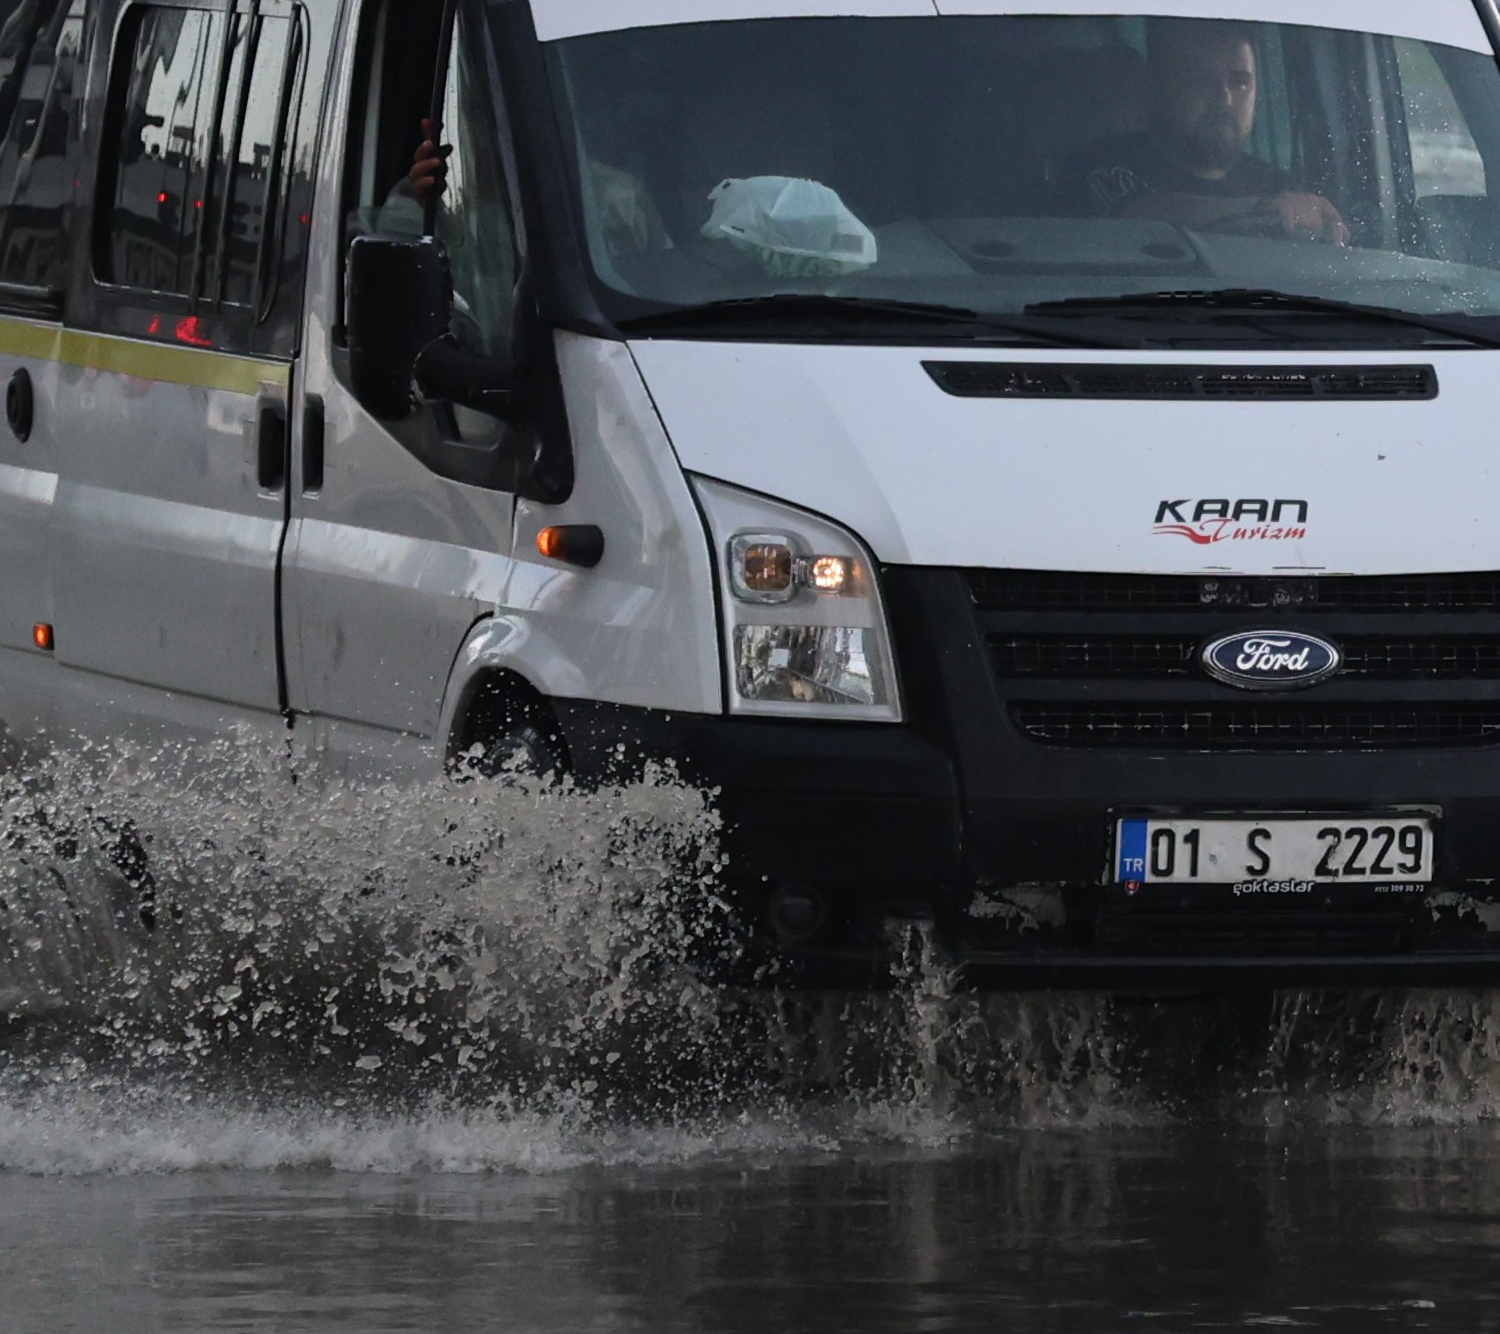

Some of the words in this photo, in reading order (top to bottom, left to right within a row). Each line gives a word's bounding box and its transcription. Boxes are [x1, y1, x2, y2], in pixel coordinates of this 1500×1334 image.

[1154, 499, 1308, 523] KAAN
[1199, 518, 1306, 543] Turizm
[1236, 638, 1311, 671] Ford
[1151, 828, 1200, 877] 01
[1245, 829, 1271, 876] S
[1314, 825, 1423, 877] 2229
[1123, 858, 1144, 872] TR
